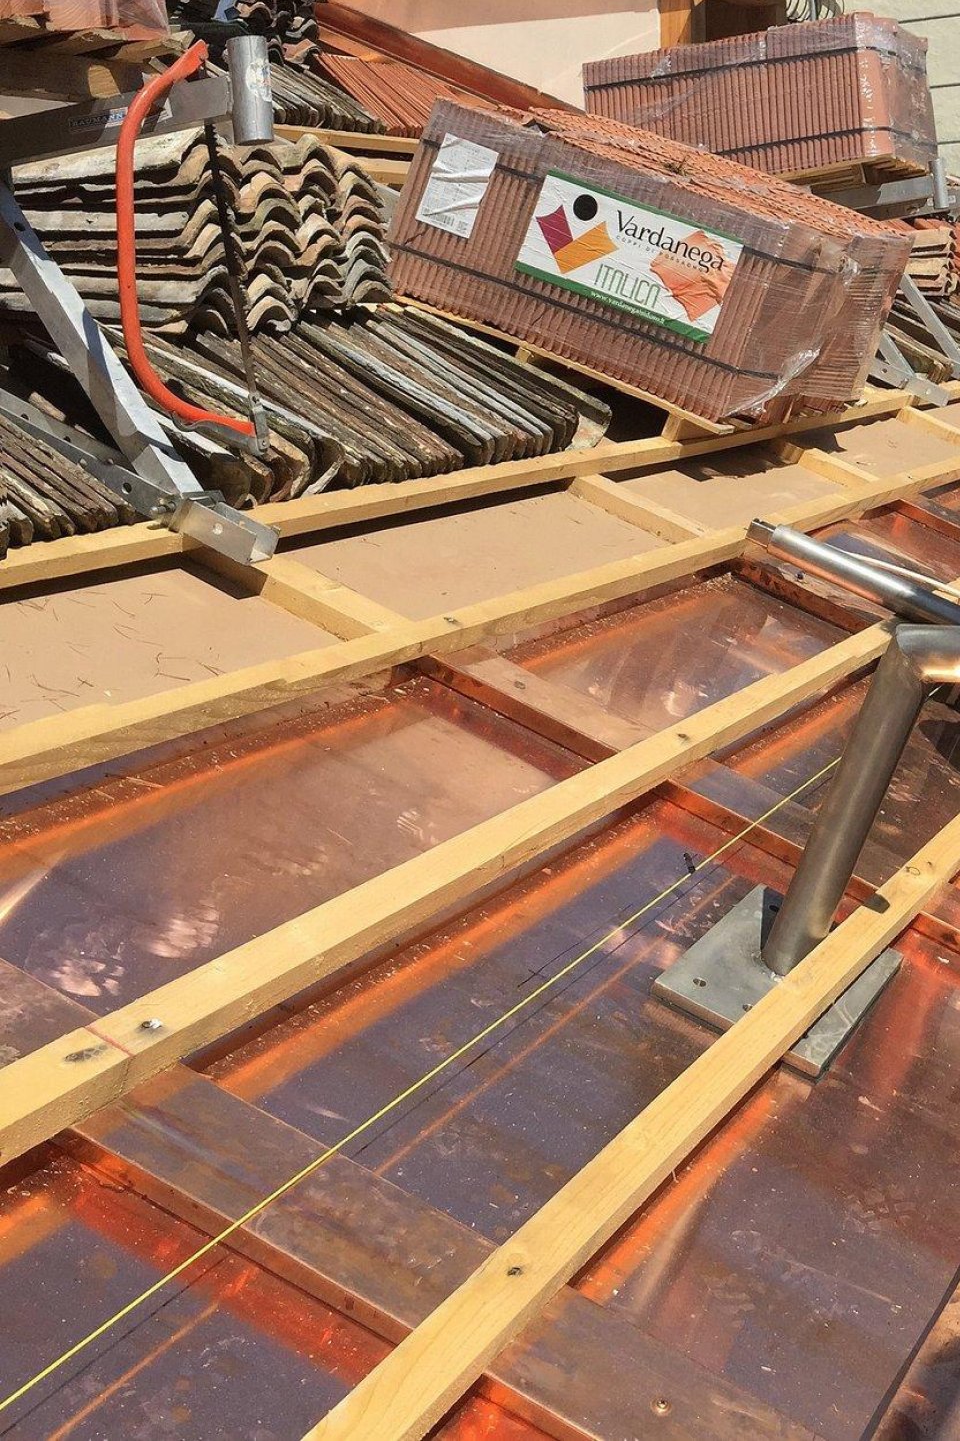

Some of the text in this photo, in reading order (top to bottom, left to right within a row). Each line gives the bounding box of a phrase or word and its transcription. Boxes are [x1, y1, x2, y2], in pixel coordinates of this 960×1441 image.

[616, 235, 641, 248] COPPI
[617, 209, 724, 273] Vardanega
[594, 263, 661, 309] ITALICA
